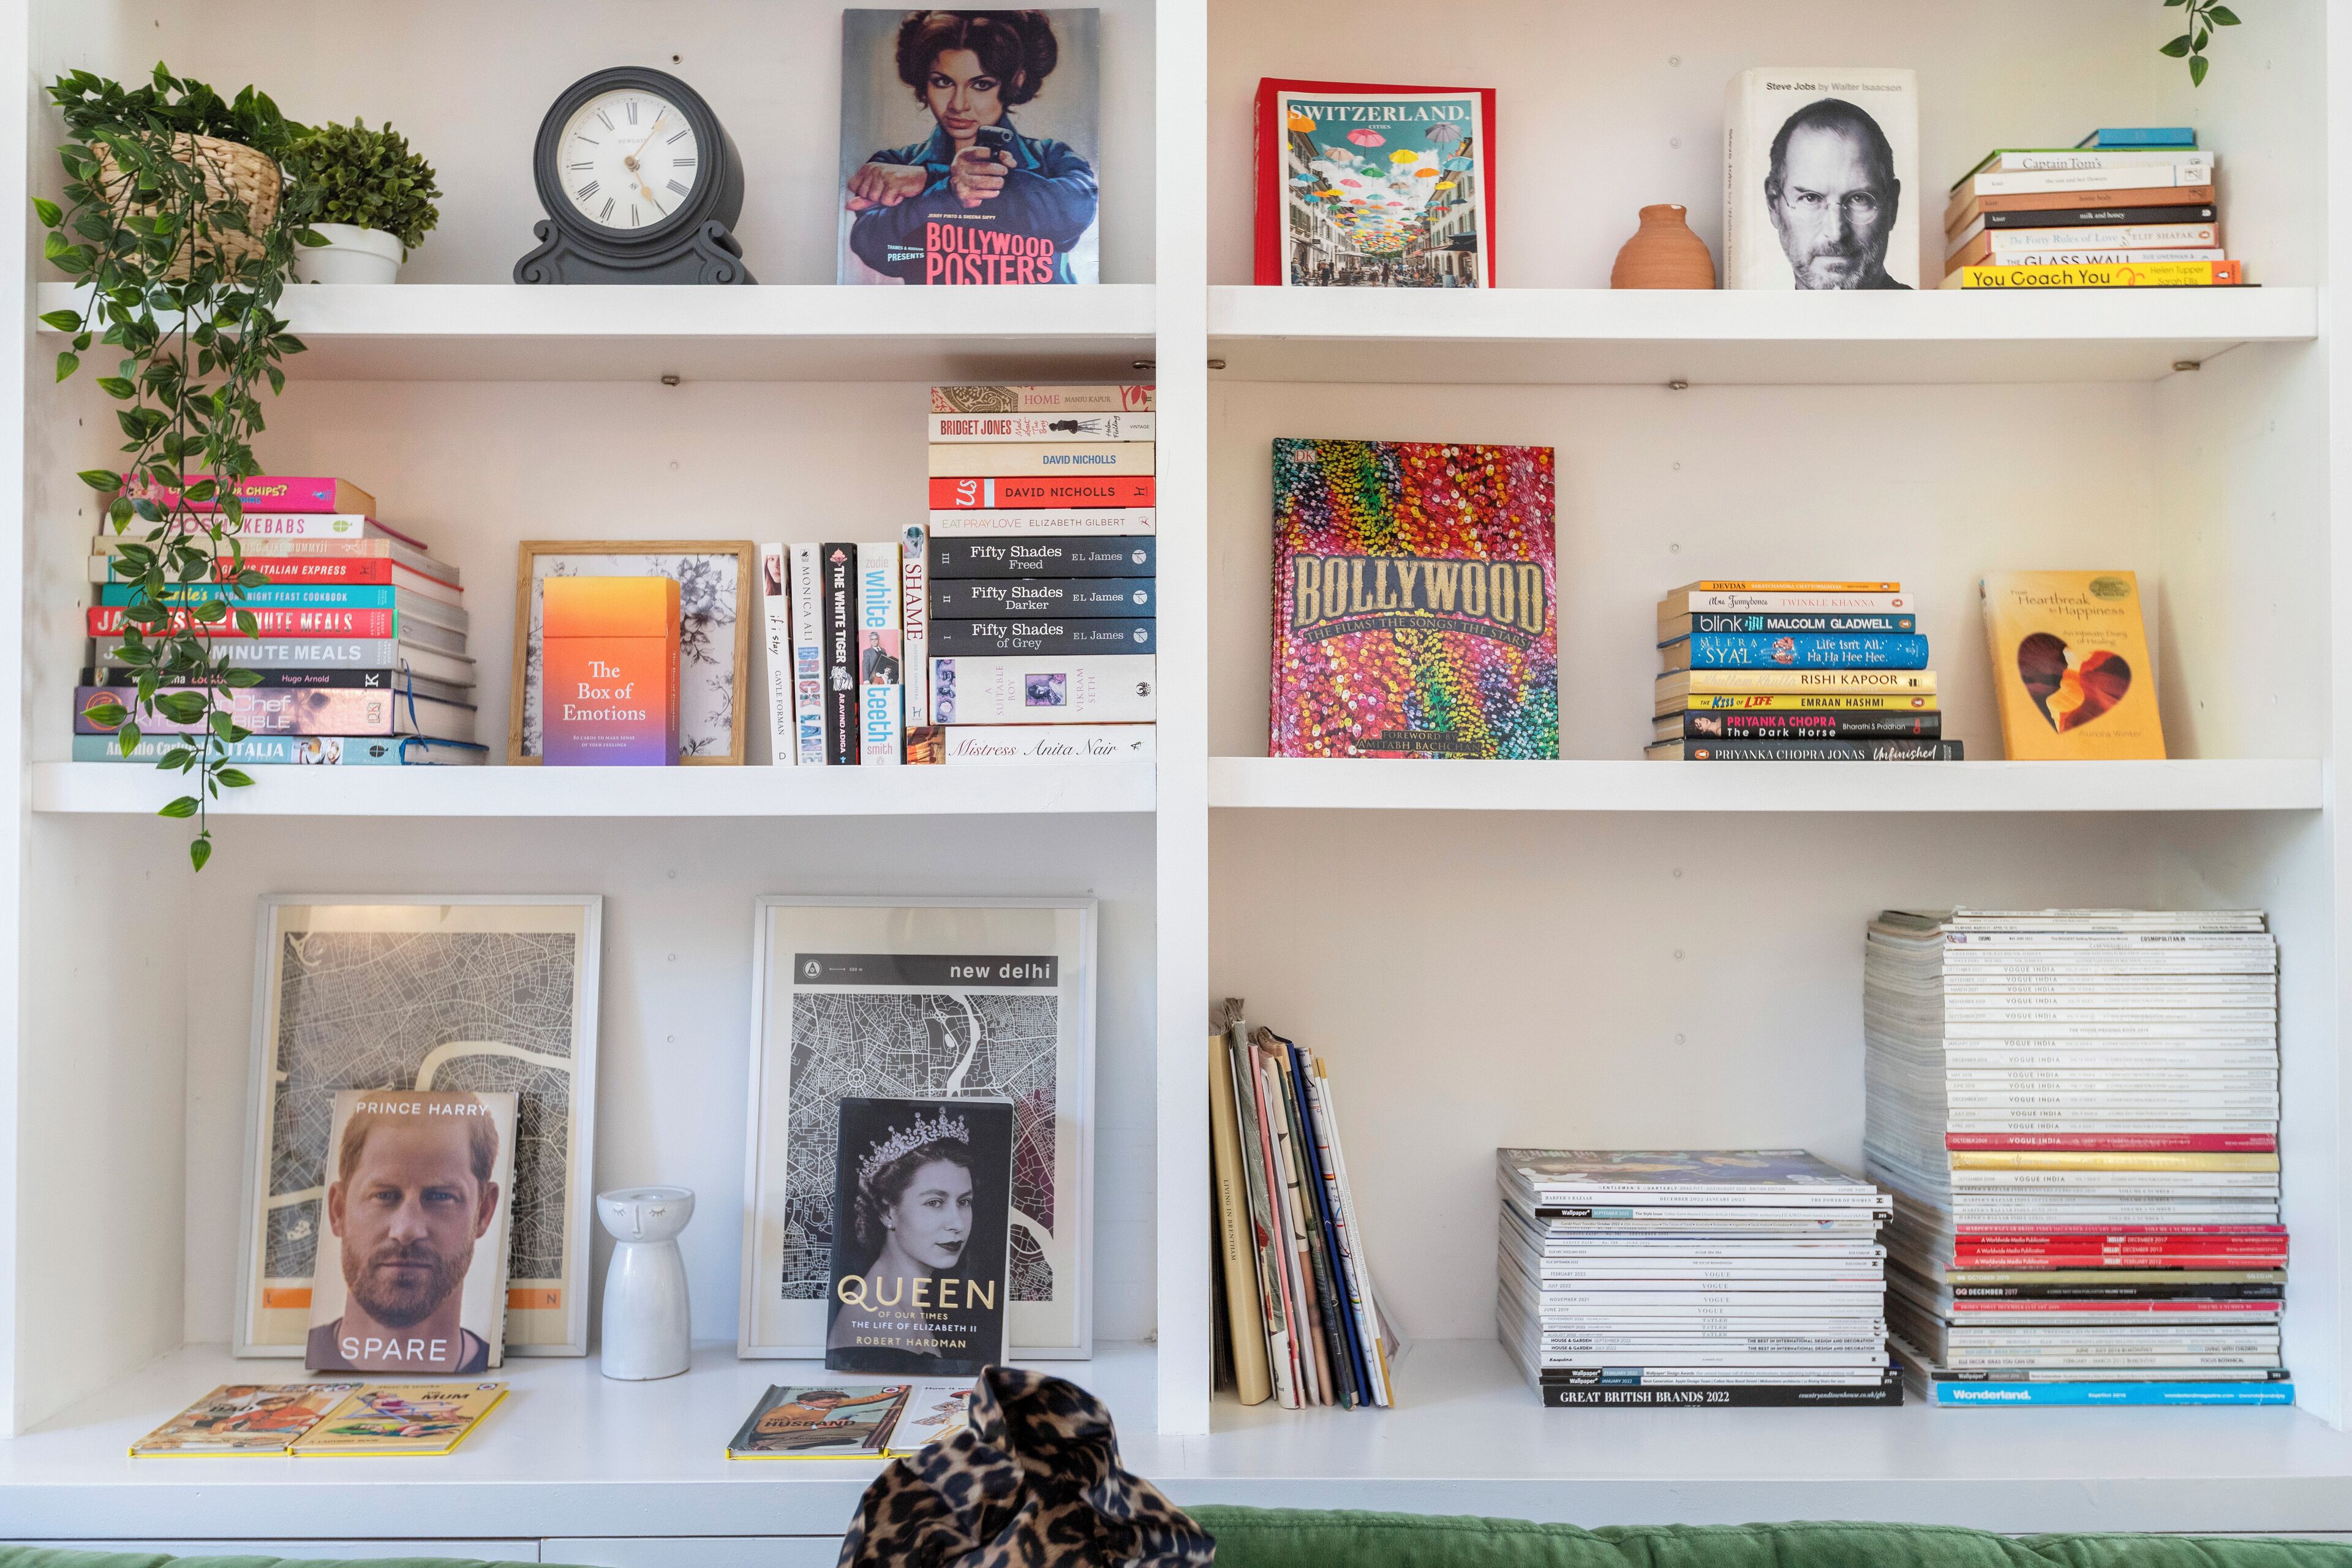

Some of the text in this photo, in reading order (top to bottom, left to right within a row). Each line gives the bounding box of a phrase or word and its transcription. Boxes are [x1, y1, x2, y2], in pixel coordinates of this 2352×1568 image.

[1818, 83, 1828, 91] by
[1862, 83, 1902, 92] Isaacson
[1290, 105, 1471, 121] SWITZERLAND.
[2023, 158, 2067, 169] Captain
[927, 222, 1054, 257] BOLLYWOOD
[888, 252, 924, 262] PRESENTS
[927, 252, 1053, 285] POSTERS
[1973, 270, 2109, 286] You Coach You
[1024, 395, 1060, 404] HOME
[941, 420, 1012, 435] BRIDGET JONES
[1043, 455, 1116, 464] DAVID NICHOLLS
[244, 518, 305, 534] KEBABS
[970, 545, 1062, 560] Fifty Shades
[1089, 552, 1122, 561] James
[260, 565, 347, 575] ITALIAN EXPRESS
[1009, 560, 1044, 570] Freed
[247, 592, 347, 602] NIGHT FEAST COOKBOOK
[802, 567, 812, 617] MONICA
[1294, 556, 1545, 635] BOLLYWOOD
[2019, 592, 2091, 606] Heartbreak
[905, 564, 922, 641] SHAME
[1006, 601, 1049, 609] Darker
[1831, 598, 1875, 608] KHANNA
[832, 565, 846, 663] THE WHITE TIGER
[2059, 606, 2125, 620] Happiness
[1700, 614, 1893, 632] blink MALCOLM GLADWELL
[1306, 617, 1531, 649] THE FILMS! THE SONGS! THE STARS!
[997, 638, 1042, 650] of Grey
[295, 646, 361, 661] MEALS
[865, 570, 893, 742] white teeth
[1706, 648, 1752, 664] SYAL
[588, 660, 620, 679] The
[282, 674, 302, 683] Hugo
[1801, 674, 1898, 685] RISHI KAPOOR
[578, 682, 634, 699] Box of
[798, 647, 823, 763] BRICK LANE
[1801, 698, 1884, 707] EMRAAN HASHMI
[562, 704, 646, 721] Emotions
[776, 698, 785, 735] FORMAN
[1727, 717, 1836, 727] PRIYANKA CHOPRA
[1727, 727, 1836, 737] The Dark Horse
[227, 742, 284, 758] ITALIA
[949, 739, 1117, 756] Mistress Anita Nair
[1358, 739, 1481, 753] AMITABH BACHCHAN
[950, 963, 1050, 979] new delhi
[356, 1102, 488, 1117] PRINCE HARRY
[1227, 1219, 1236, 1260] BRENTHAM
[837, 1275, 995, 1313] QUEEN
[914, 1324, 967, 1332] ELIZABETH
[341, 1336, 447, 1361] SPARE
[856, 1336, 966, 1348] ROBERT HARDMAN
[1560, 1392, 1730, 1403] GREAT BRITISH BRANDS 2022
[1953, 1390, 2031, 1400] Wonderland.
